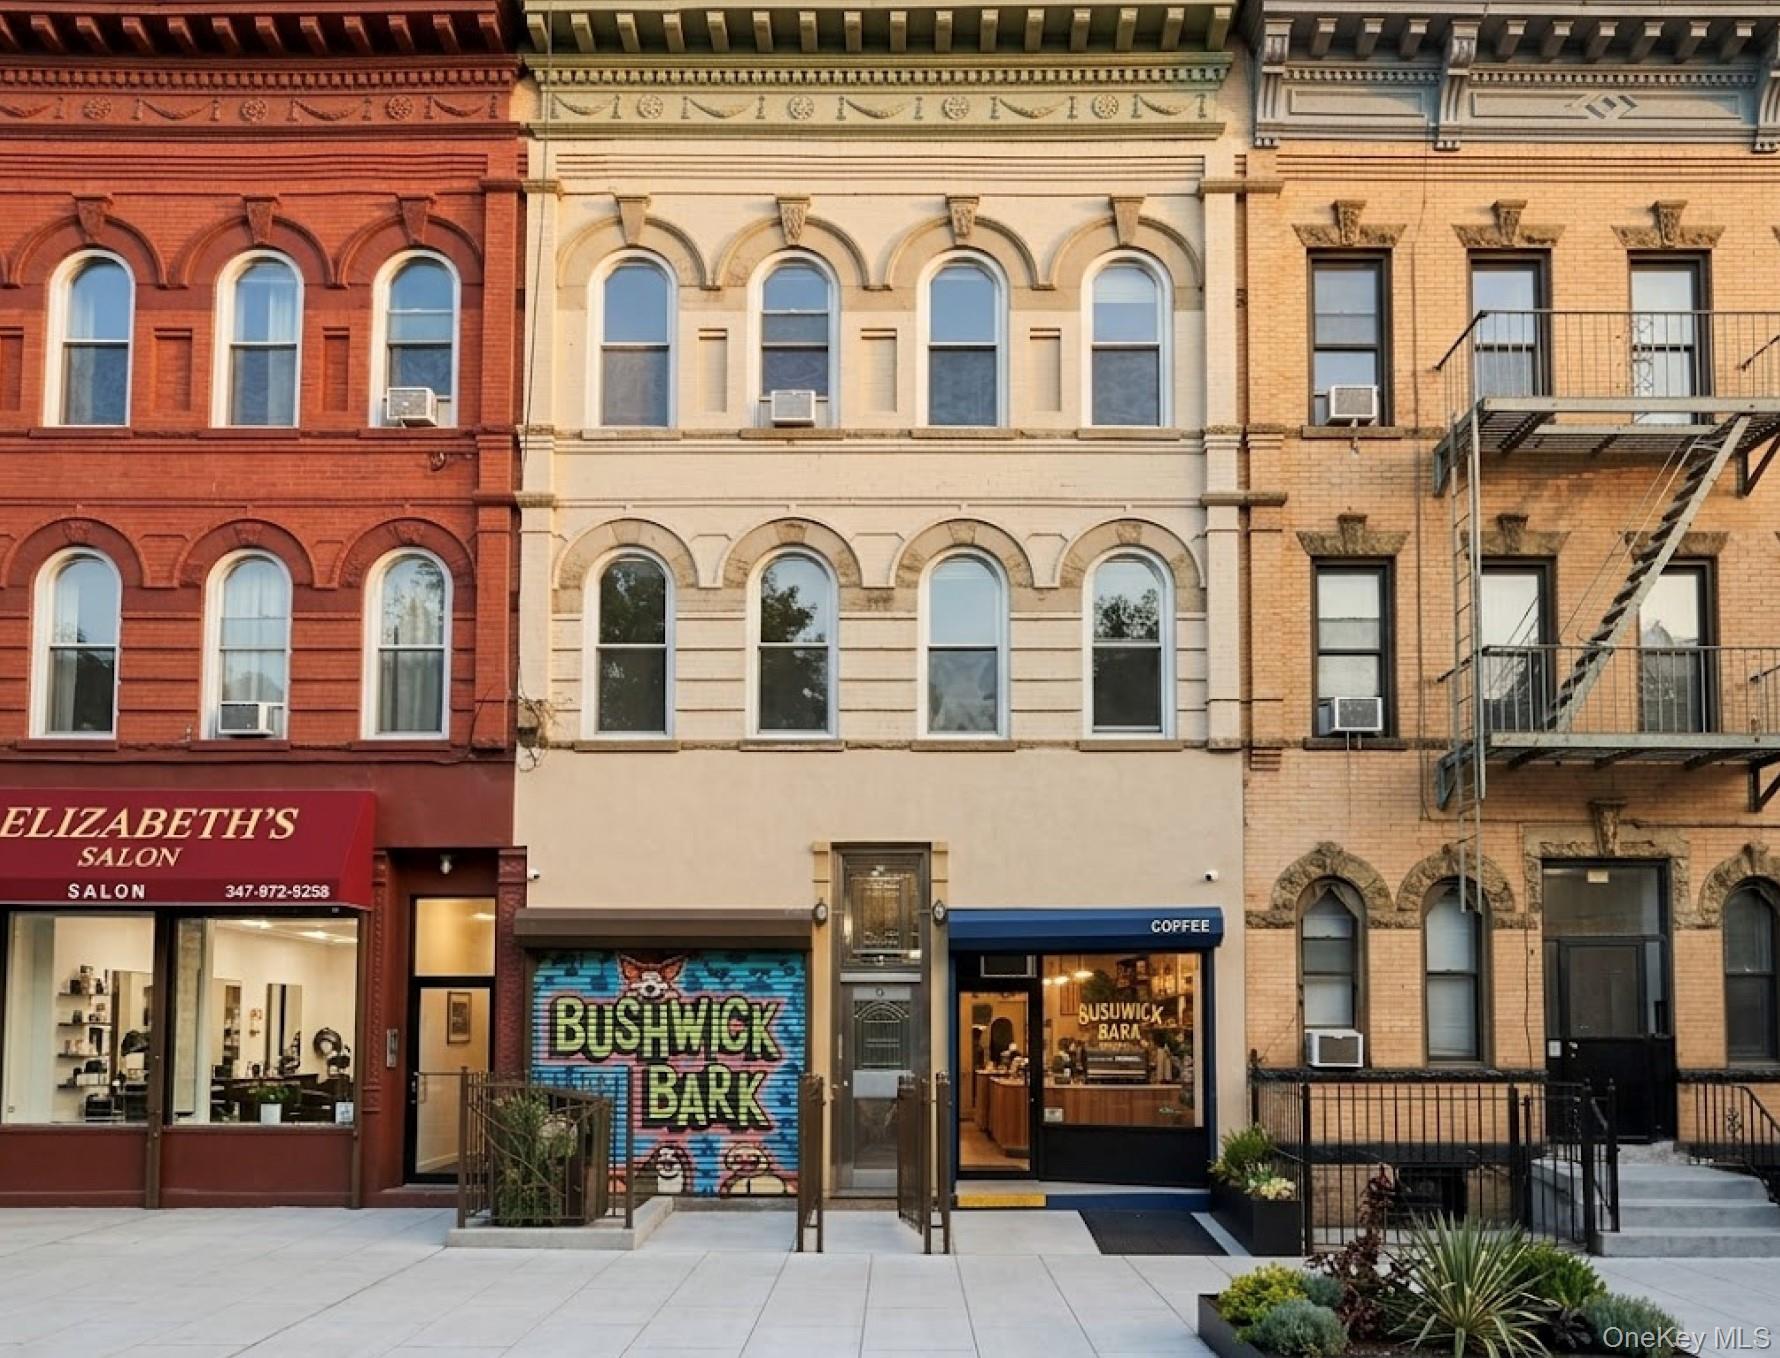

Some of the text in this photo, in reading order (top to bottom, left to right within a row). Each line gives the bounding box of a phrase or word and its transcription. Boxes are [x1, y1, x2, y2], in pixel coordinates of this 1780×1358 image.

[0, 806, 300, 840] ELIZABETH'S
[77, 846, 182, 868] SALON
[67, 883, 147, 900] SALON
[225, 884, 331, 899] 347-972-9258
[551, 996, 782, 1060] BUSHWICK
[643, 1064, 772, 1129] BARK
